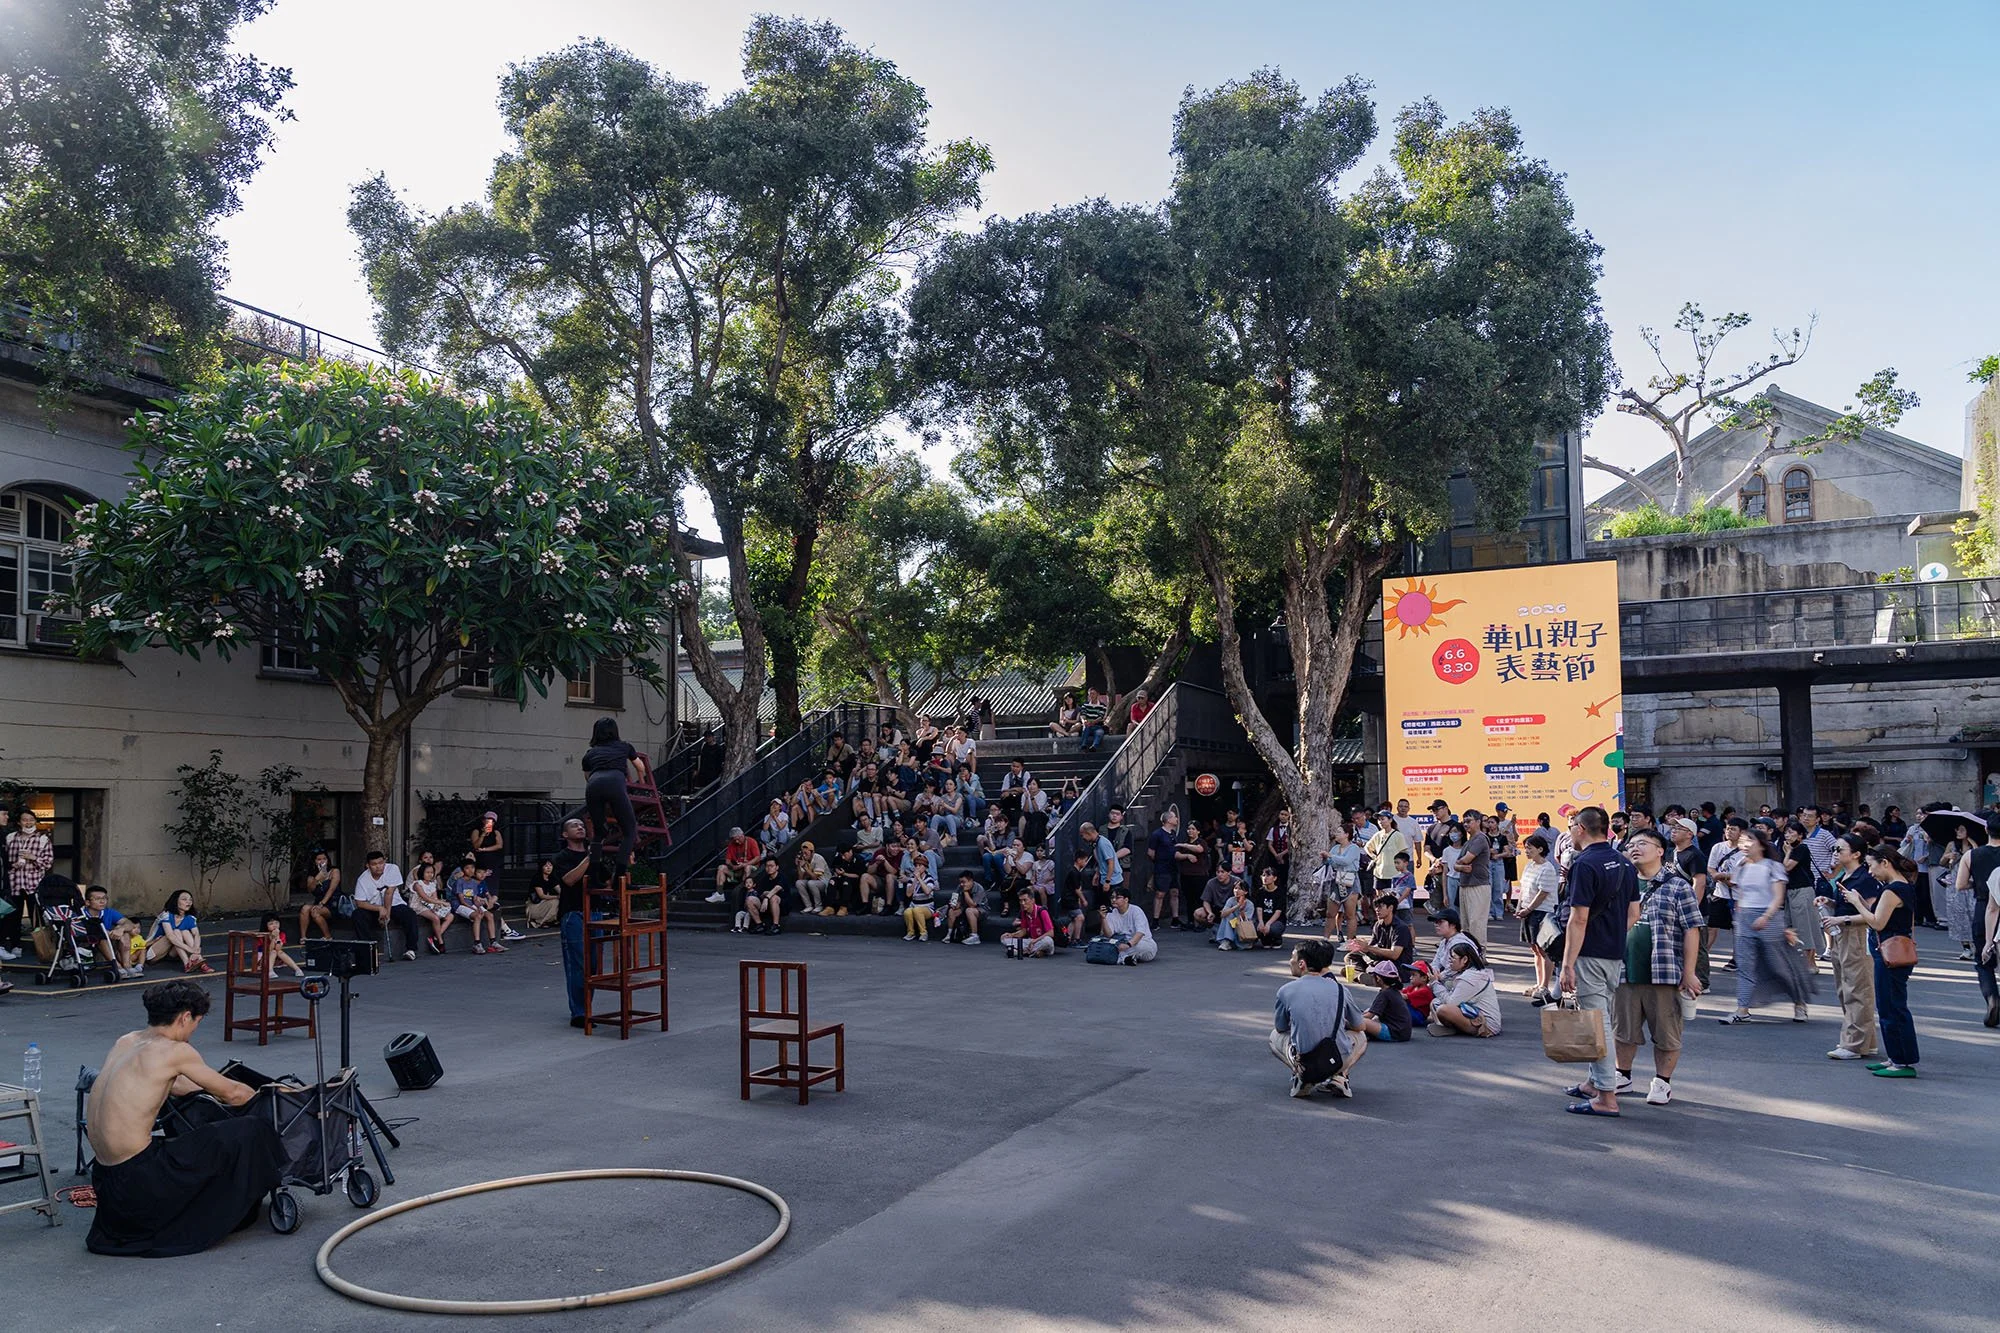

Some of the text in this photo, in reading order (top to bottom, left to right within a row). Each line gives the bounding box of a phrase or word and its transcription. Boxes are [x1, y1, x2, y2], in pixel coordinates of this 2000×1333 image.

[1517, 603, 1567, 617] 2026
[1482, 617, 1608, 653] 華山親子
[1443, 648, 1466, 660] 6.6
[1442, 661, 1474, 674] 8.30
[1496, 651, 1595, 684] 表藝節
